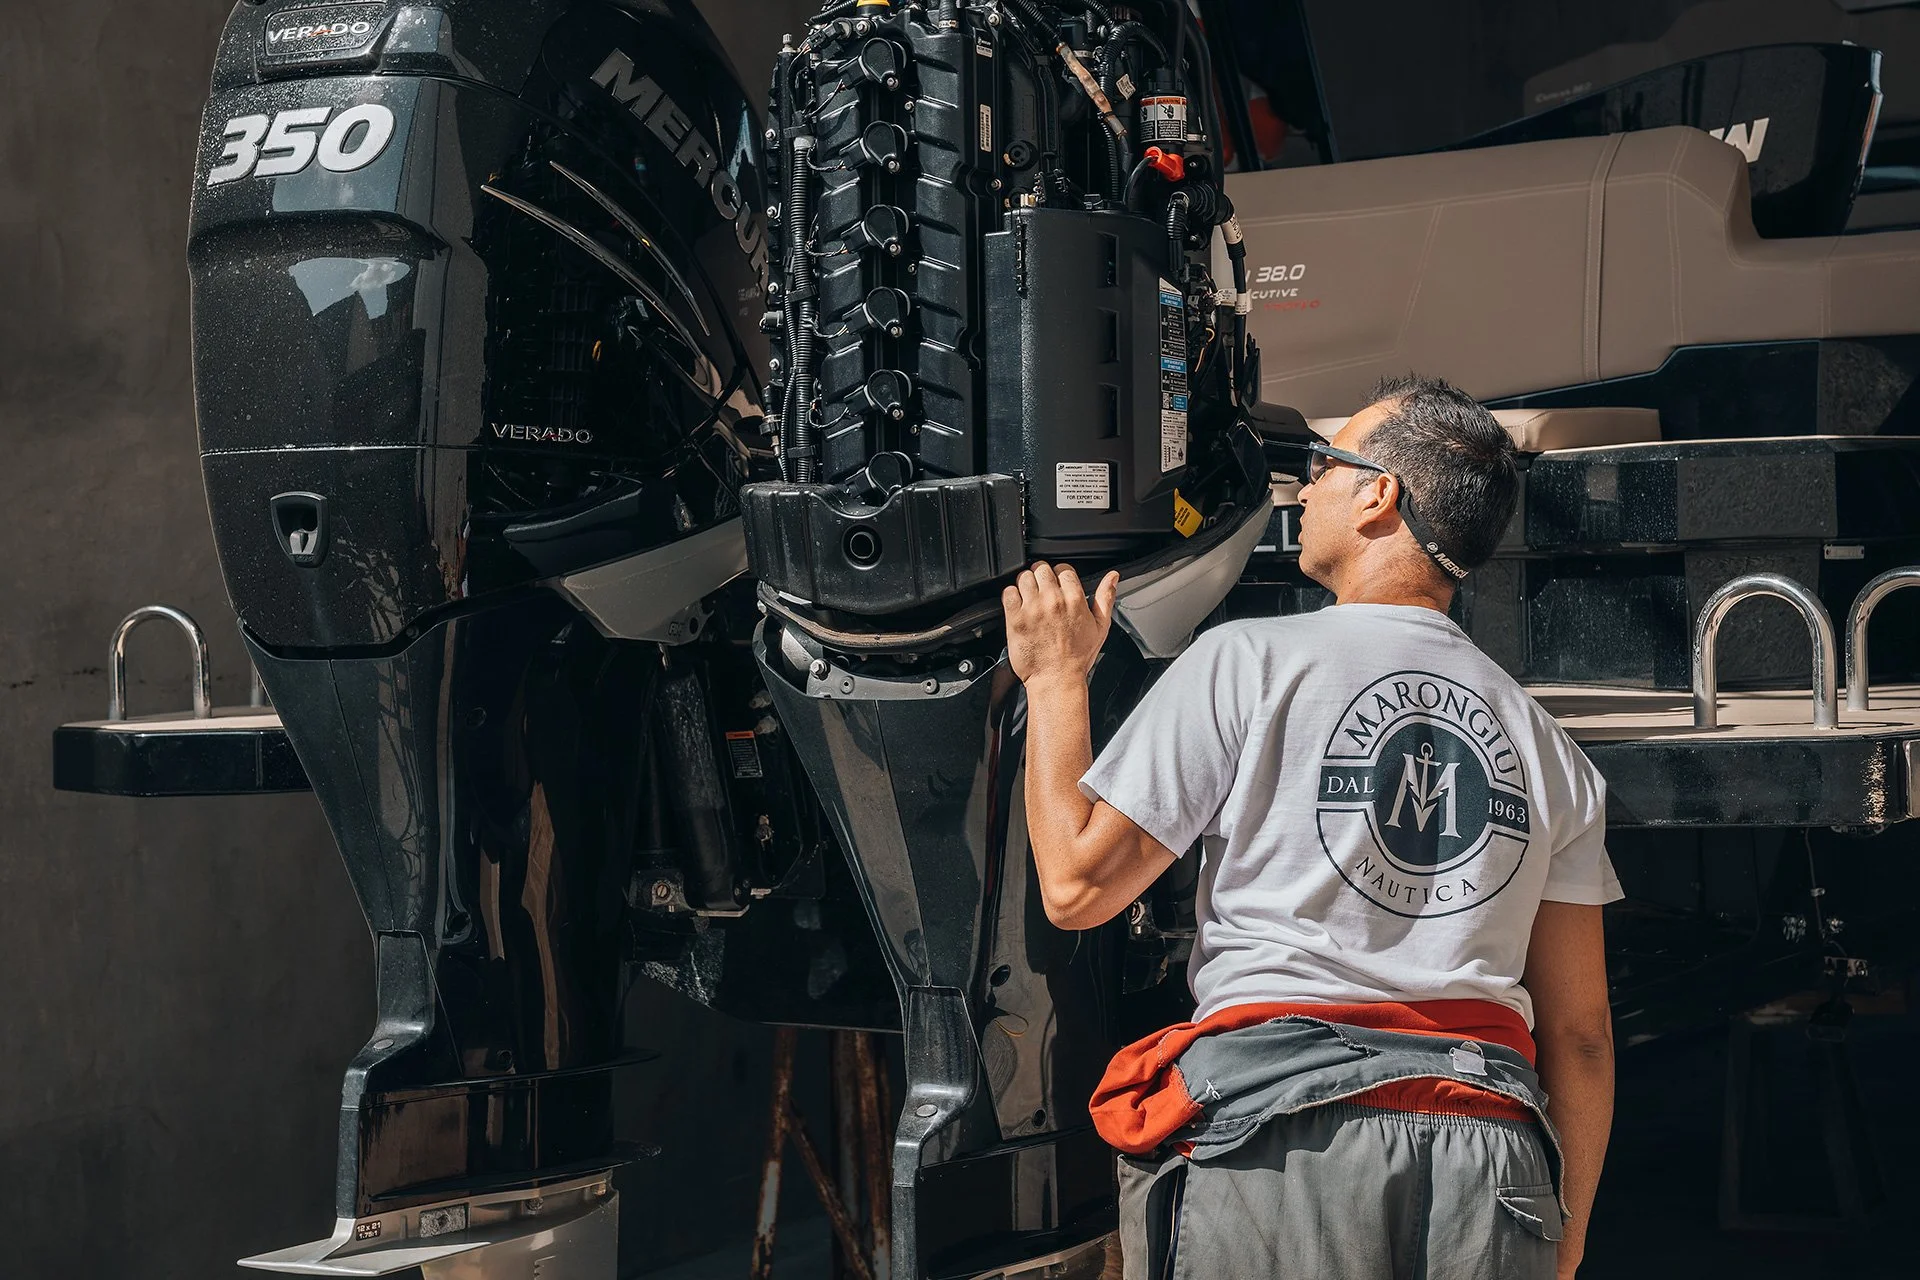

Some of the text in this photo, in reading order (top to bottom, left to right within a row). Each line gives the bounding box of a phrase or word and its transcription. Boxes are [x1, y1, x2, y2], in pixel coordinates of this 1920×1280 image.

[267, 21, 371, 43] VERADO
[207, 103, 396, 188] 350
[1256, 264, 1306, 283] 38.0
[490, 422, 594, 444] VERADO
[1344, 681, 1518, 775] MARONGIU
[1326, 776, 1375, 794] DAL
[1487, 797, 1526, 824] 1963
[1356, 856, 1477, 904] NAUTICA
